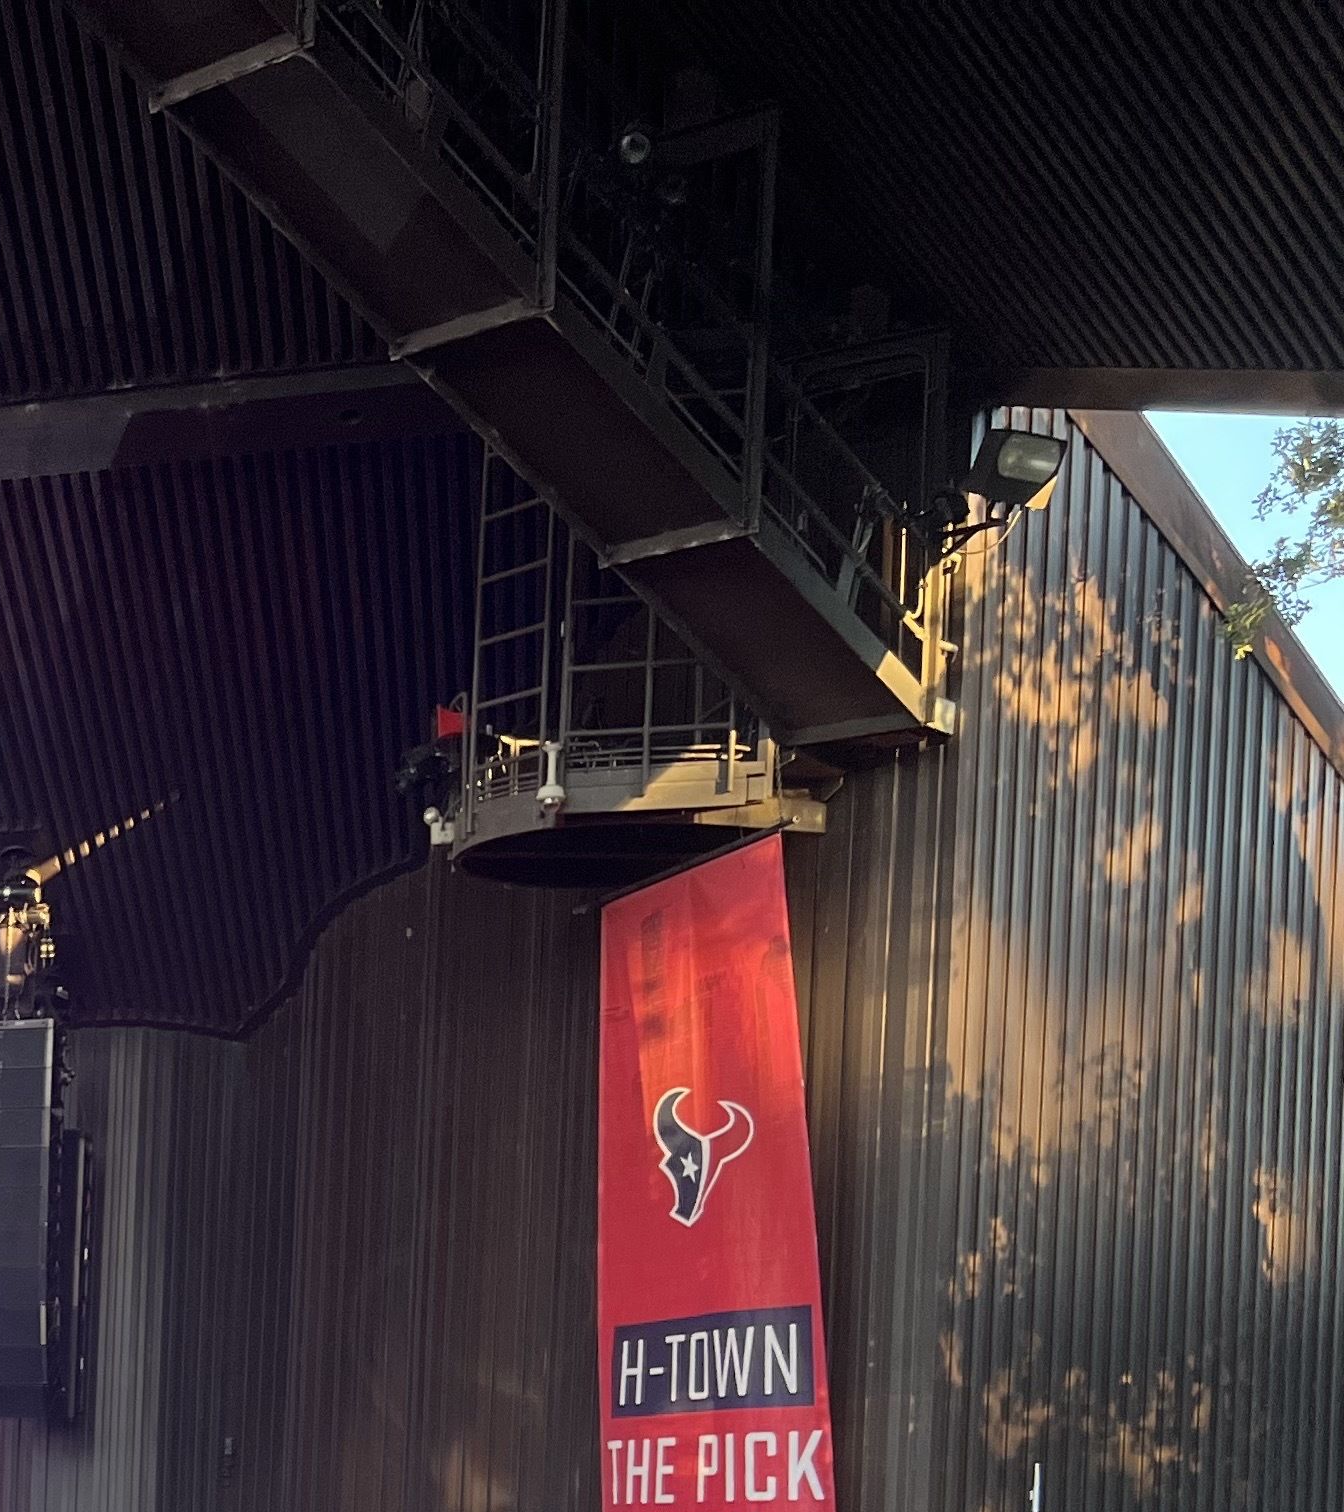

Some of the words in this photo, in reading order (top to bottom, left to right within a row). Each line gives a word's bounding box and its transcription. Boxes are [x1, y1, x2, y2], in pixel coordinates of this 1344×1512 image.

[618, 1322, 798, 1407] H-TOWN
[606, 1436, 677, 1505] THE
[696, 1428, 825, 1503] PICK
